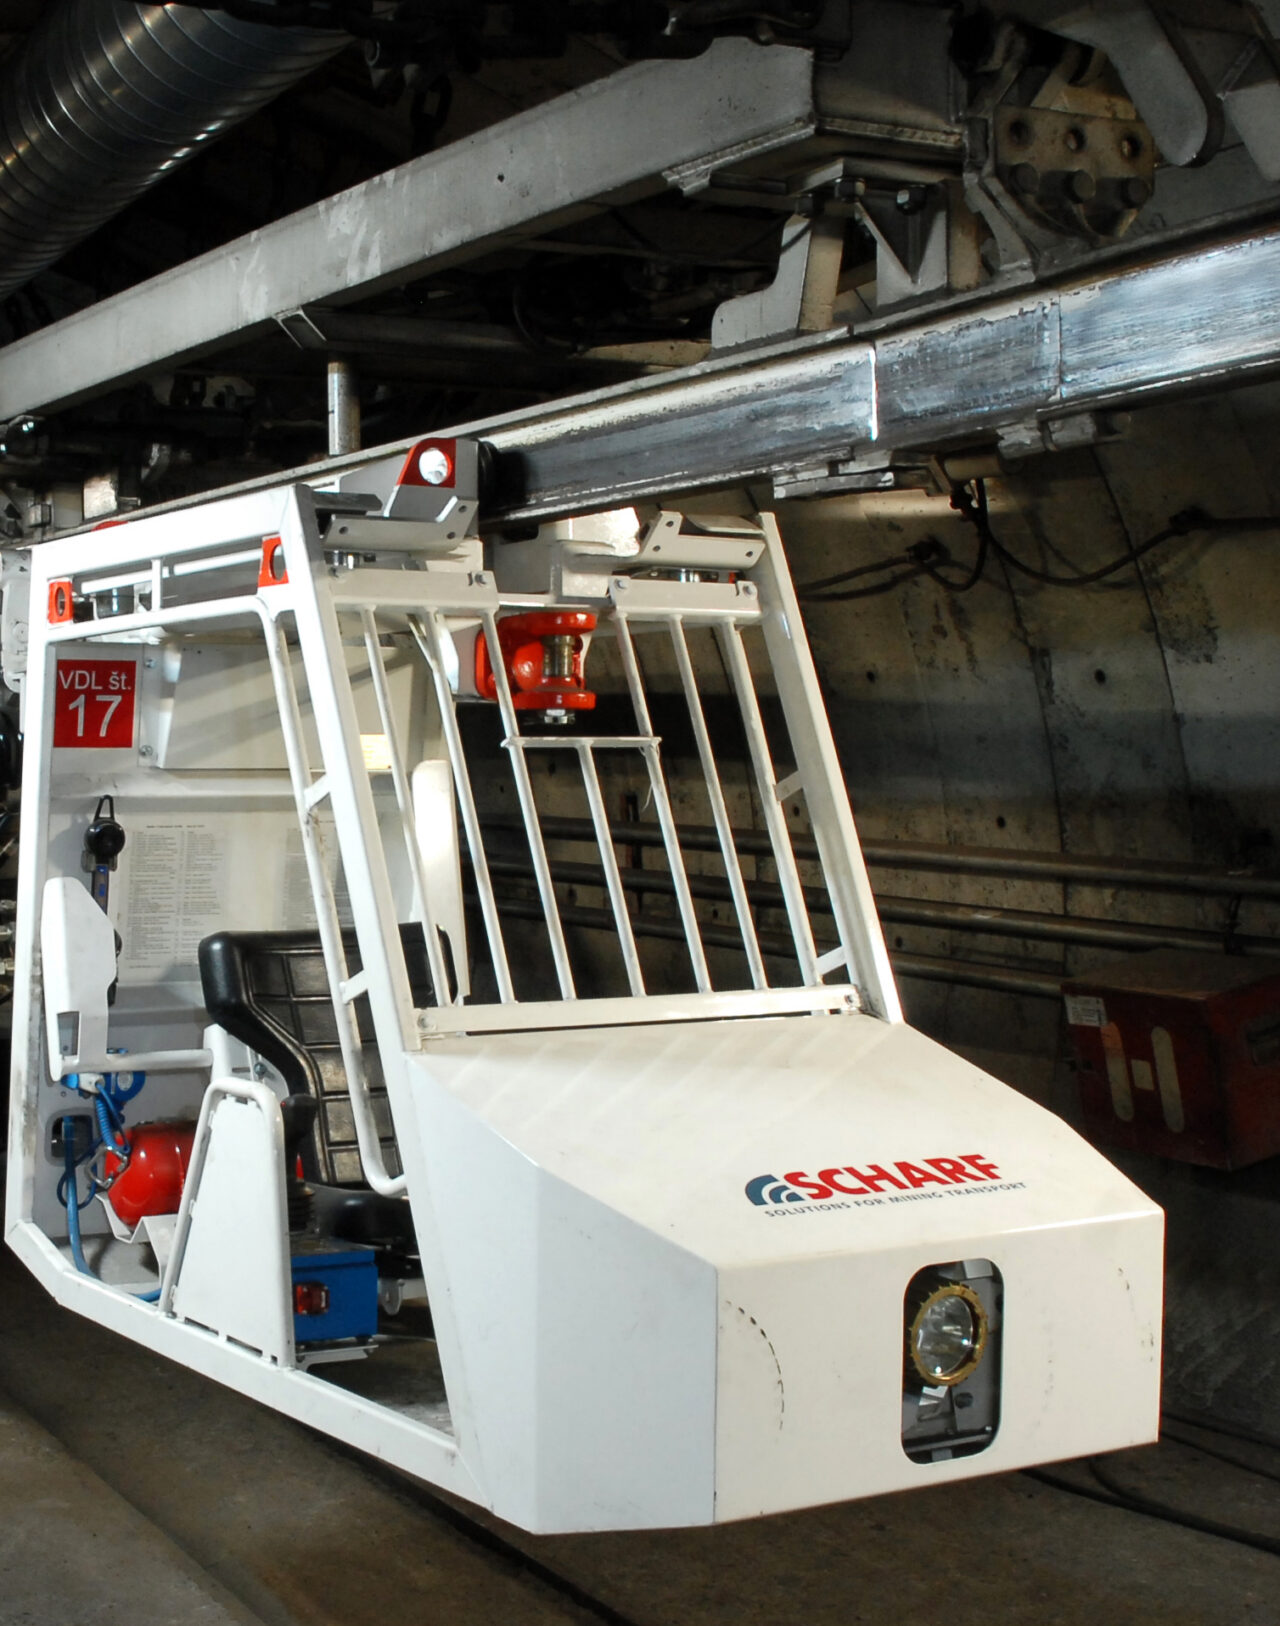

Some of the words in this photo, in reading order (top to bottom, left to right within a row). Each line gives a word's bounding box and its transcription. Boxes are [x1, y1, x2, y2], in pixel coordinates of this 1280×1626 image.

[58, 670, 103, 690] VDL
[108, 671, 132, 690] št.
[68, 693, 122, 738] 17
[783, 1153, 1003, 1200] SCHARF
[764, 1201, 852, 1218] SOLUTIONS
[854, 1197, 884, 1208] FOR
[888, 1191, 944, 1205] MINING
[946, 1181, 1027, 1196] TRANSPORT
